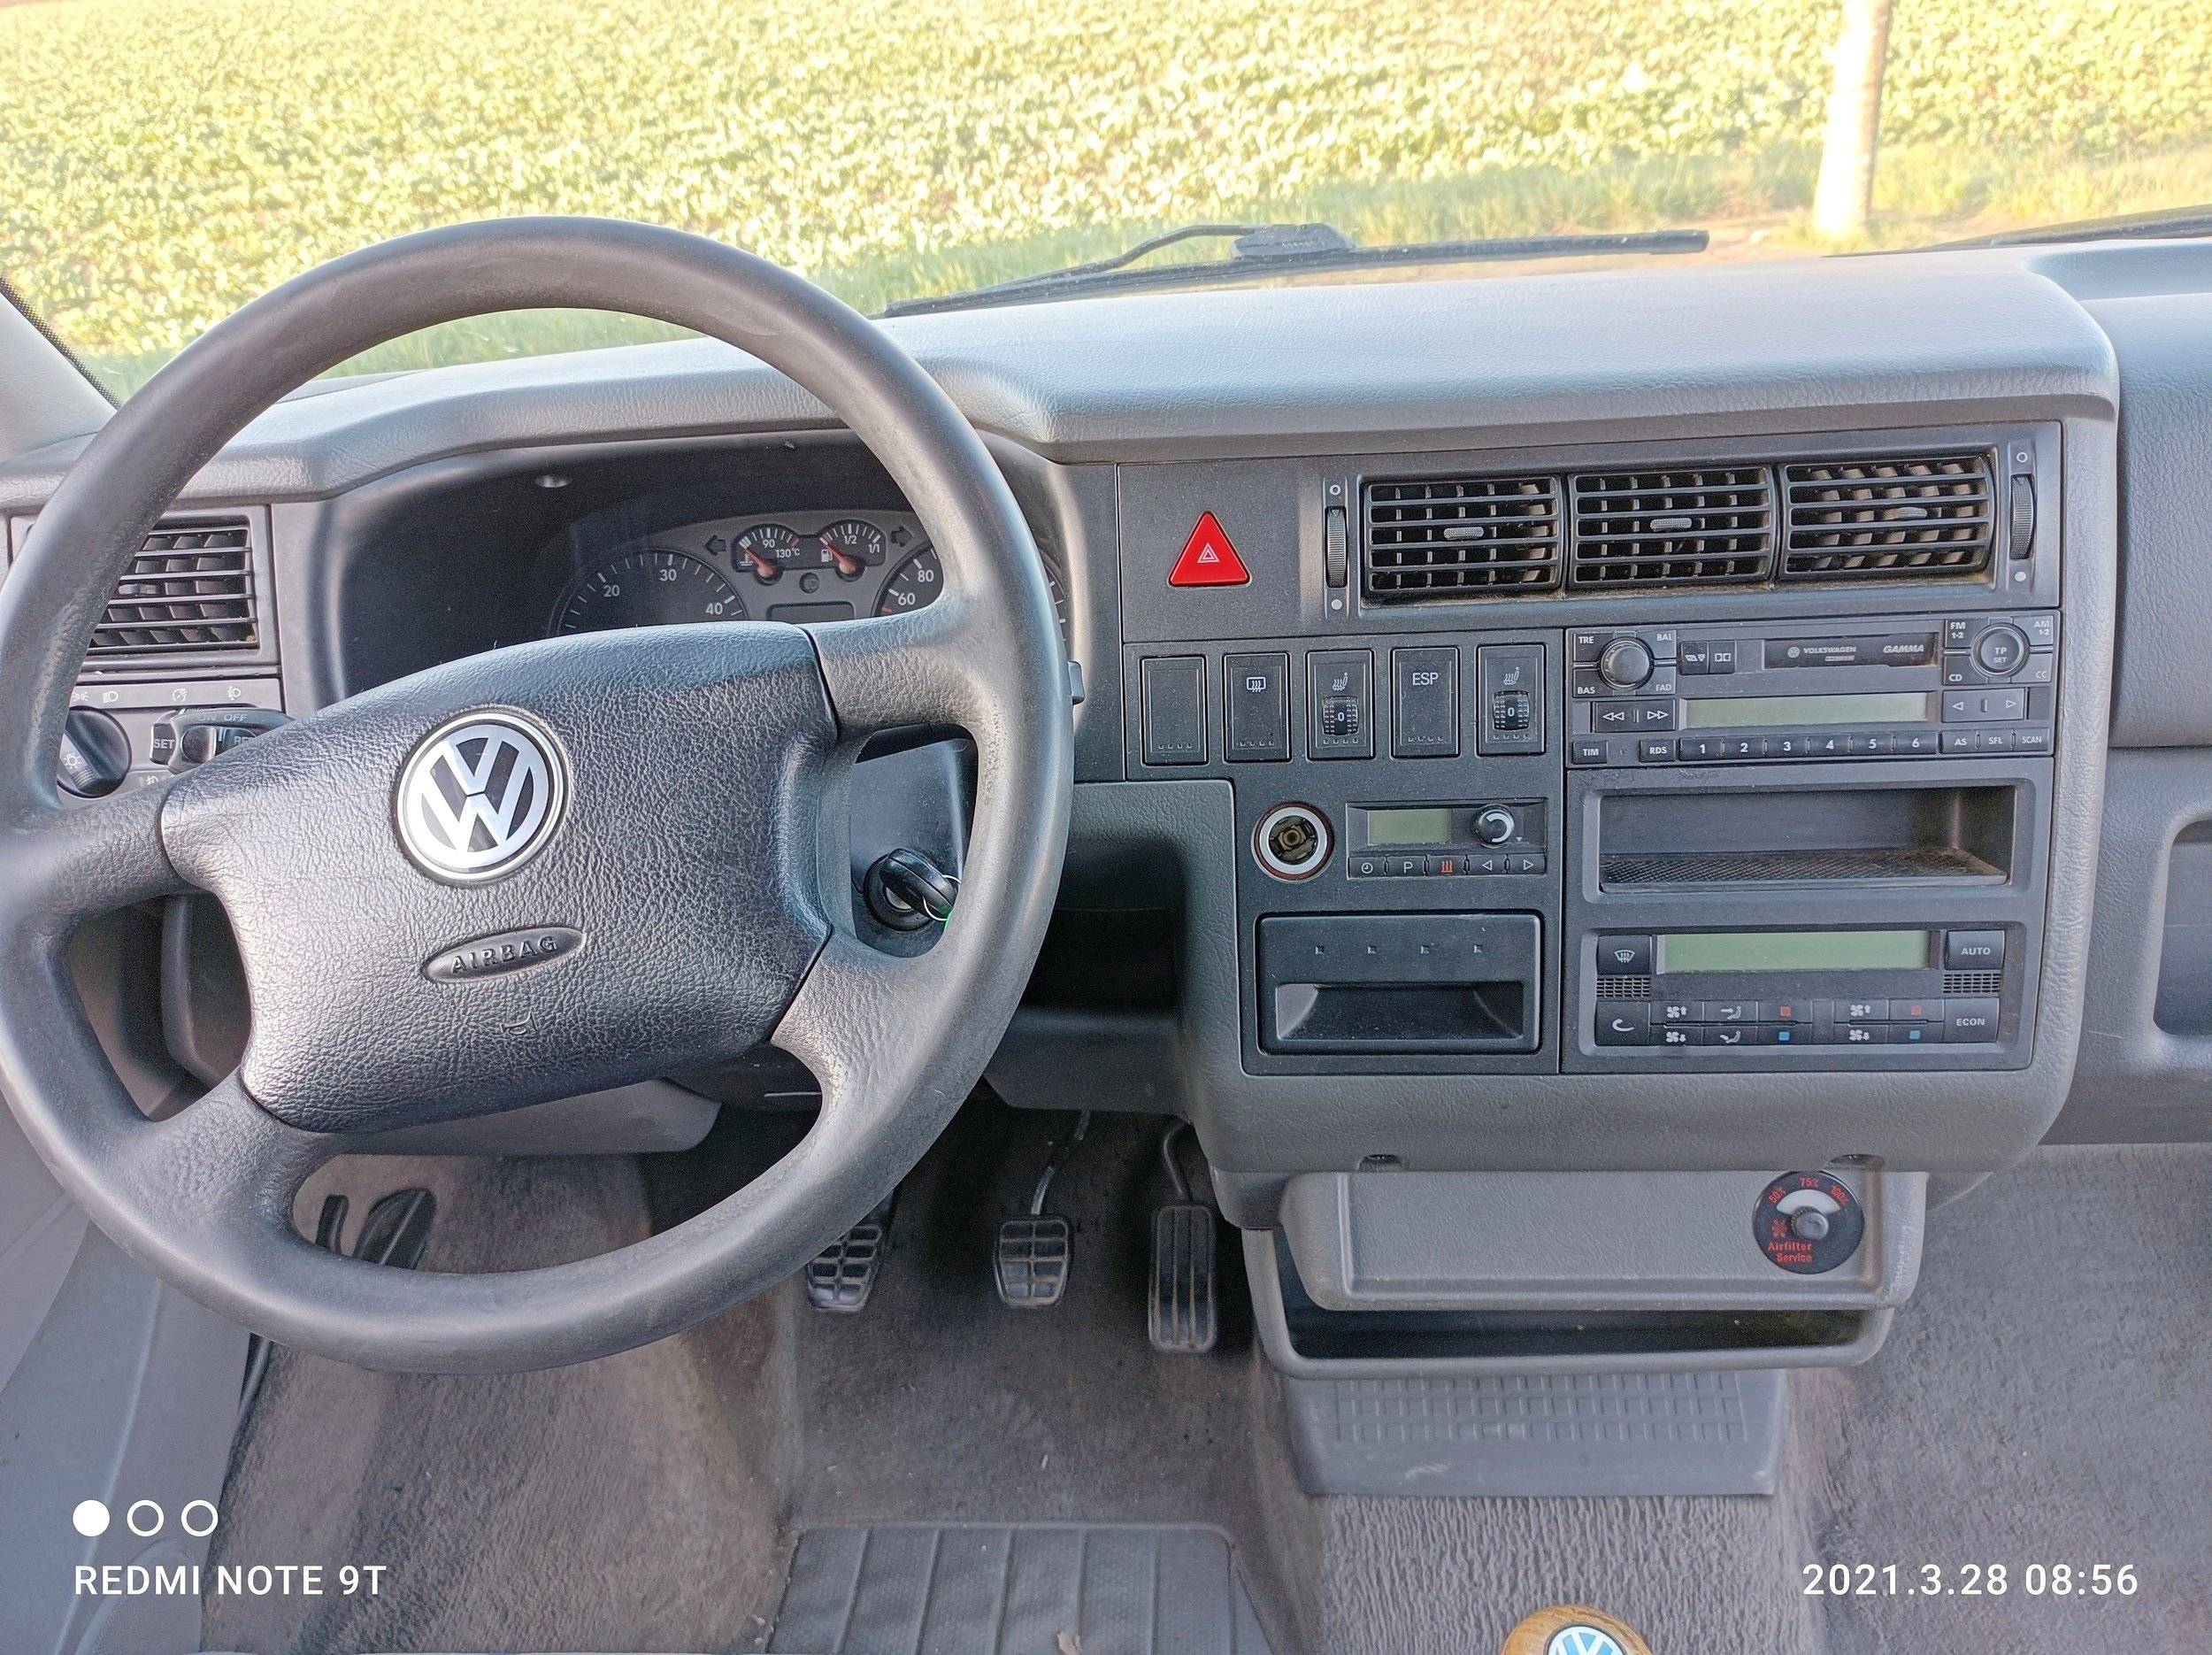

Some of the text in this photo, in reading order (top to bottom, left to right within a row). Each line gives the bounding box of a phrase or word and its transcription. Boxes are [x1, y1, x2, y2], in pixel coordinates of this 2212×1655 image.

[763, 538, 776, 549] 90
[844, 535, 857, 545] 1/2
[869, 543, 881, 554] 1/1
[659, 569, 677, 581] 30
[917, 570, 934, 582] 80
[603, 585, 620, 597] 20
[897, 593, 916, 605] 60
[705, 603, 723, 615] 40
[1950, 621, 1966, 630] FM
[1656, 633, 1672, 642] BAL
[1883, 644, 1924, 654] GAMMA
[1412, 673, 1439, 686] ESP
[1948, 674, 1962, 682] CD
[153, 738, 175, 750] SET
[2022, 735, 2042, 743] SCAN
[1649, 746, 1667, 755] RDS
[1700, 737, 1920, 754] 1 2 3 4 5 6
[1583, 748, 1599, 757] TIM
[1403, 862, 1413, 873] P
[451, 935, 558, 974] AIRBAG
[1961, 946, 1991, 956] AUTO
[1956, 1017, 1985, 1027] ECON
[1768, 1242, 1812, 1251] Airfilter
[1777, 1252, 1813, 1262] Service
